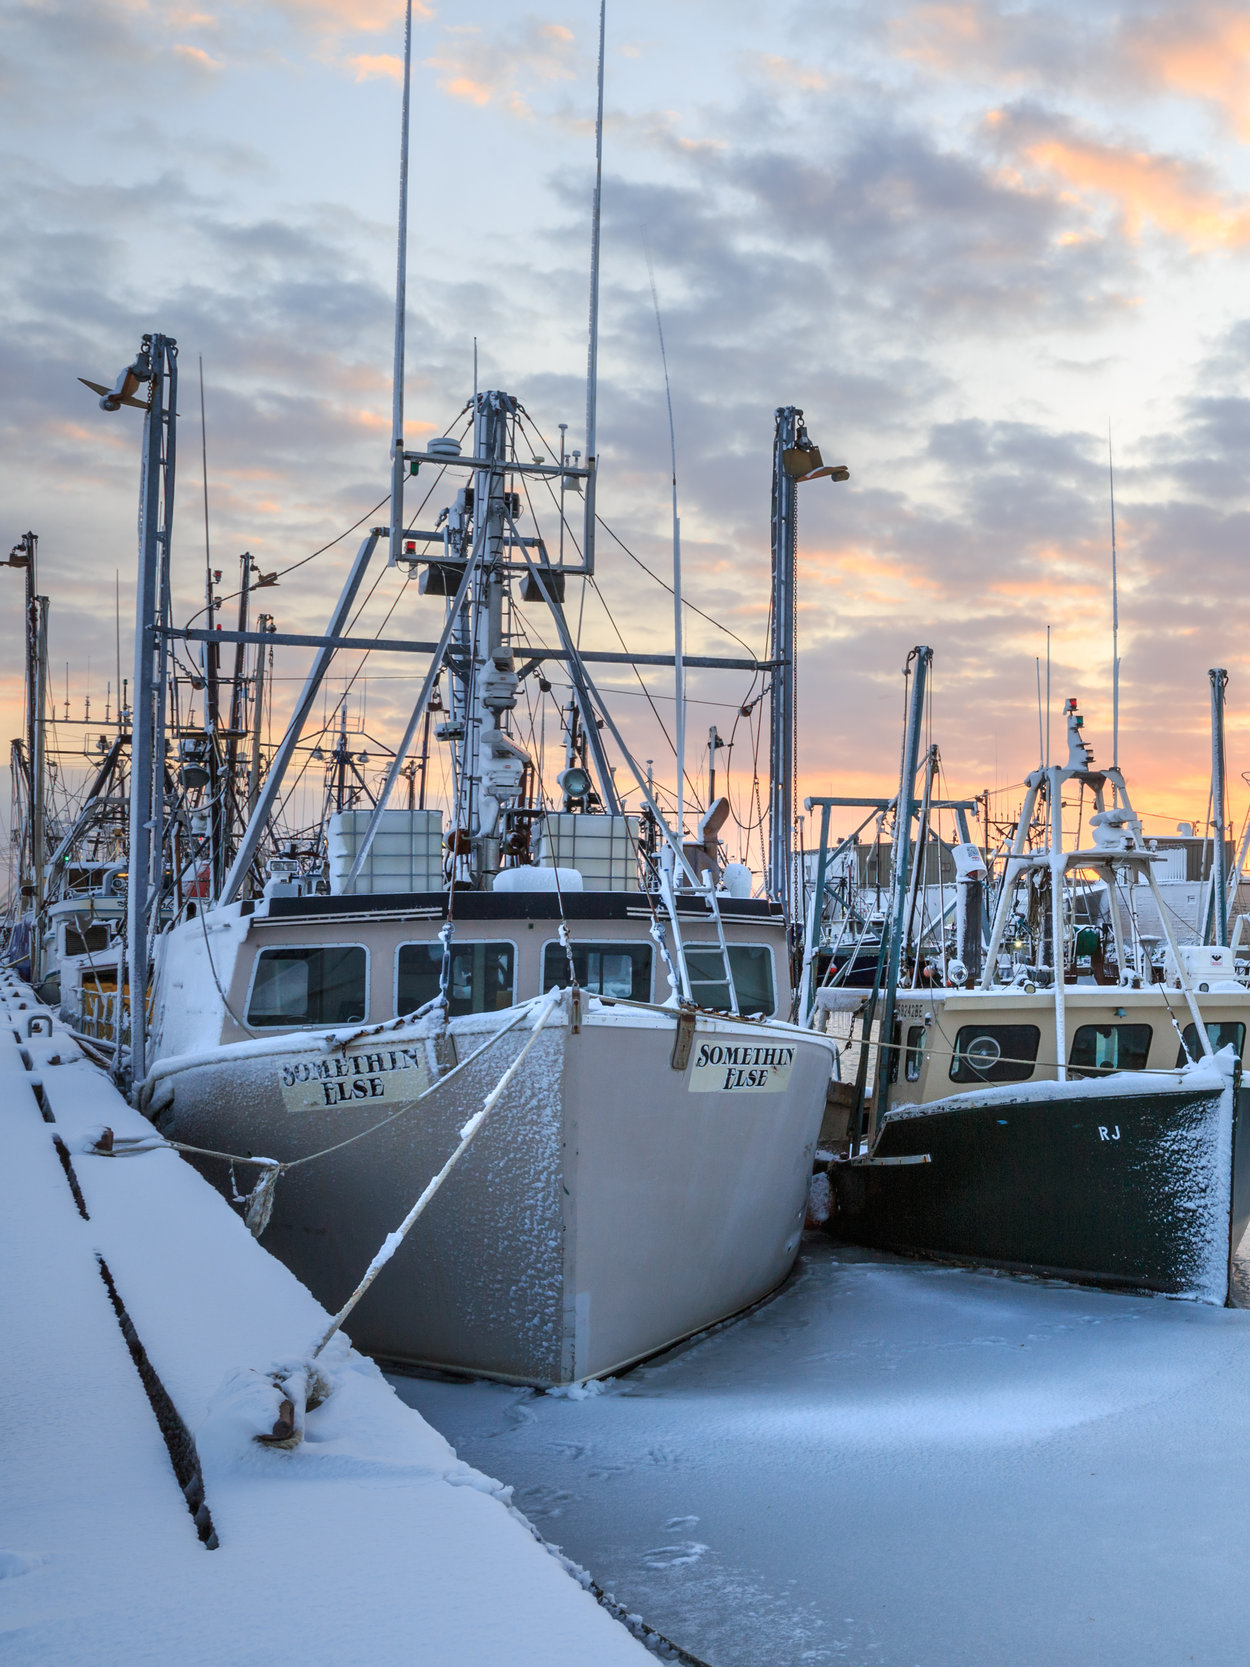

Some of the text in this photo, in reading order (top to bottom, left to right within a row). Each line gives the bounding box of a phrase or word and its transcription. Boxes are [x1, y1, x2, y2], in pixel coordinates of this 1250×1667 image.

[282, 1048, 419, 1087] SOMETHIN
[696, 1044, 796, 1068] SOMETHIN
[723, 1067, 768, 1090] ELSE
[321, 1077, 385, 1106] ELSE
[1098, 1125, 1121, 1141] RJ
